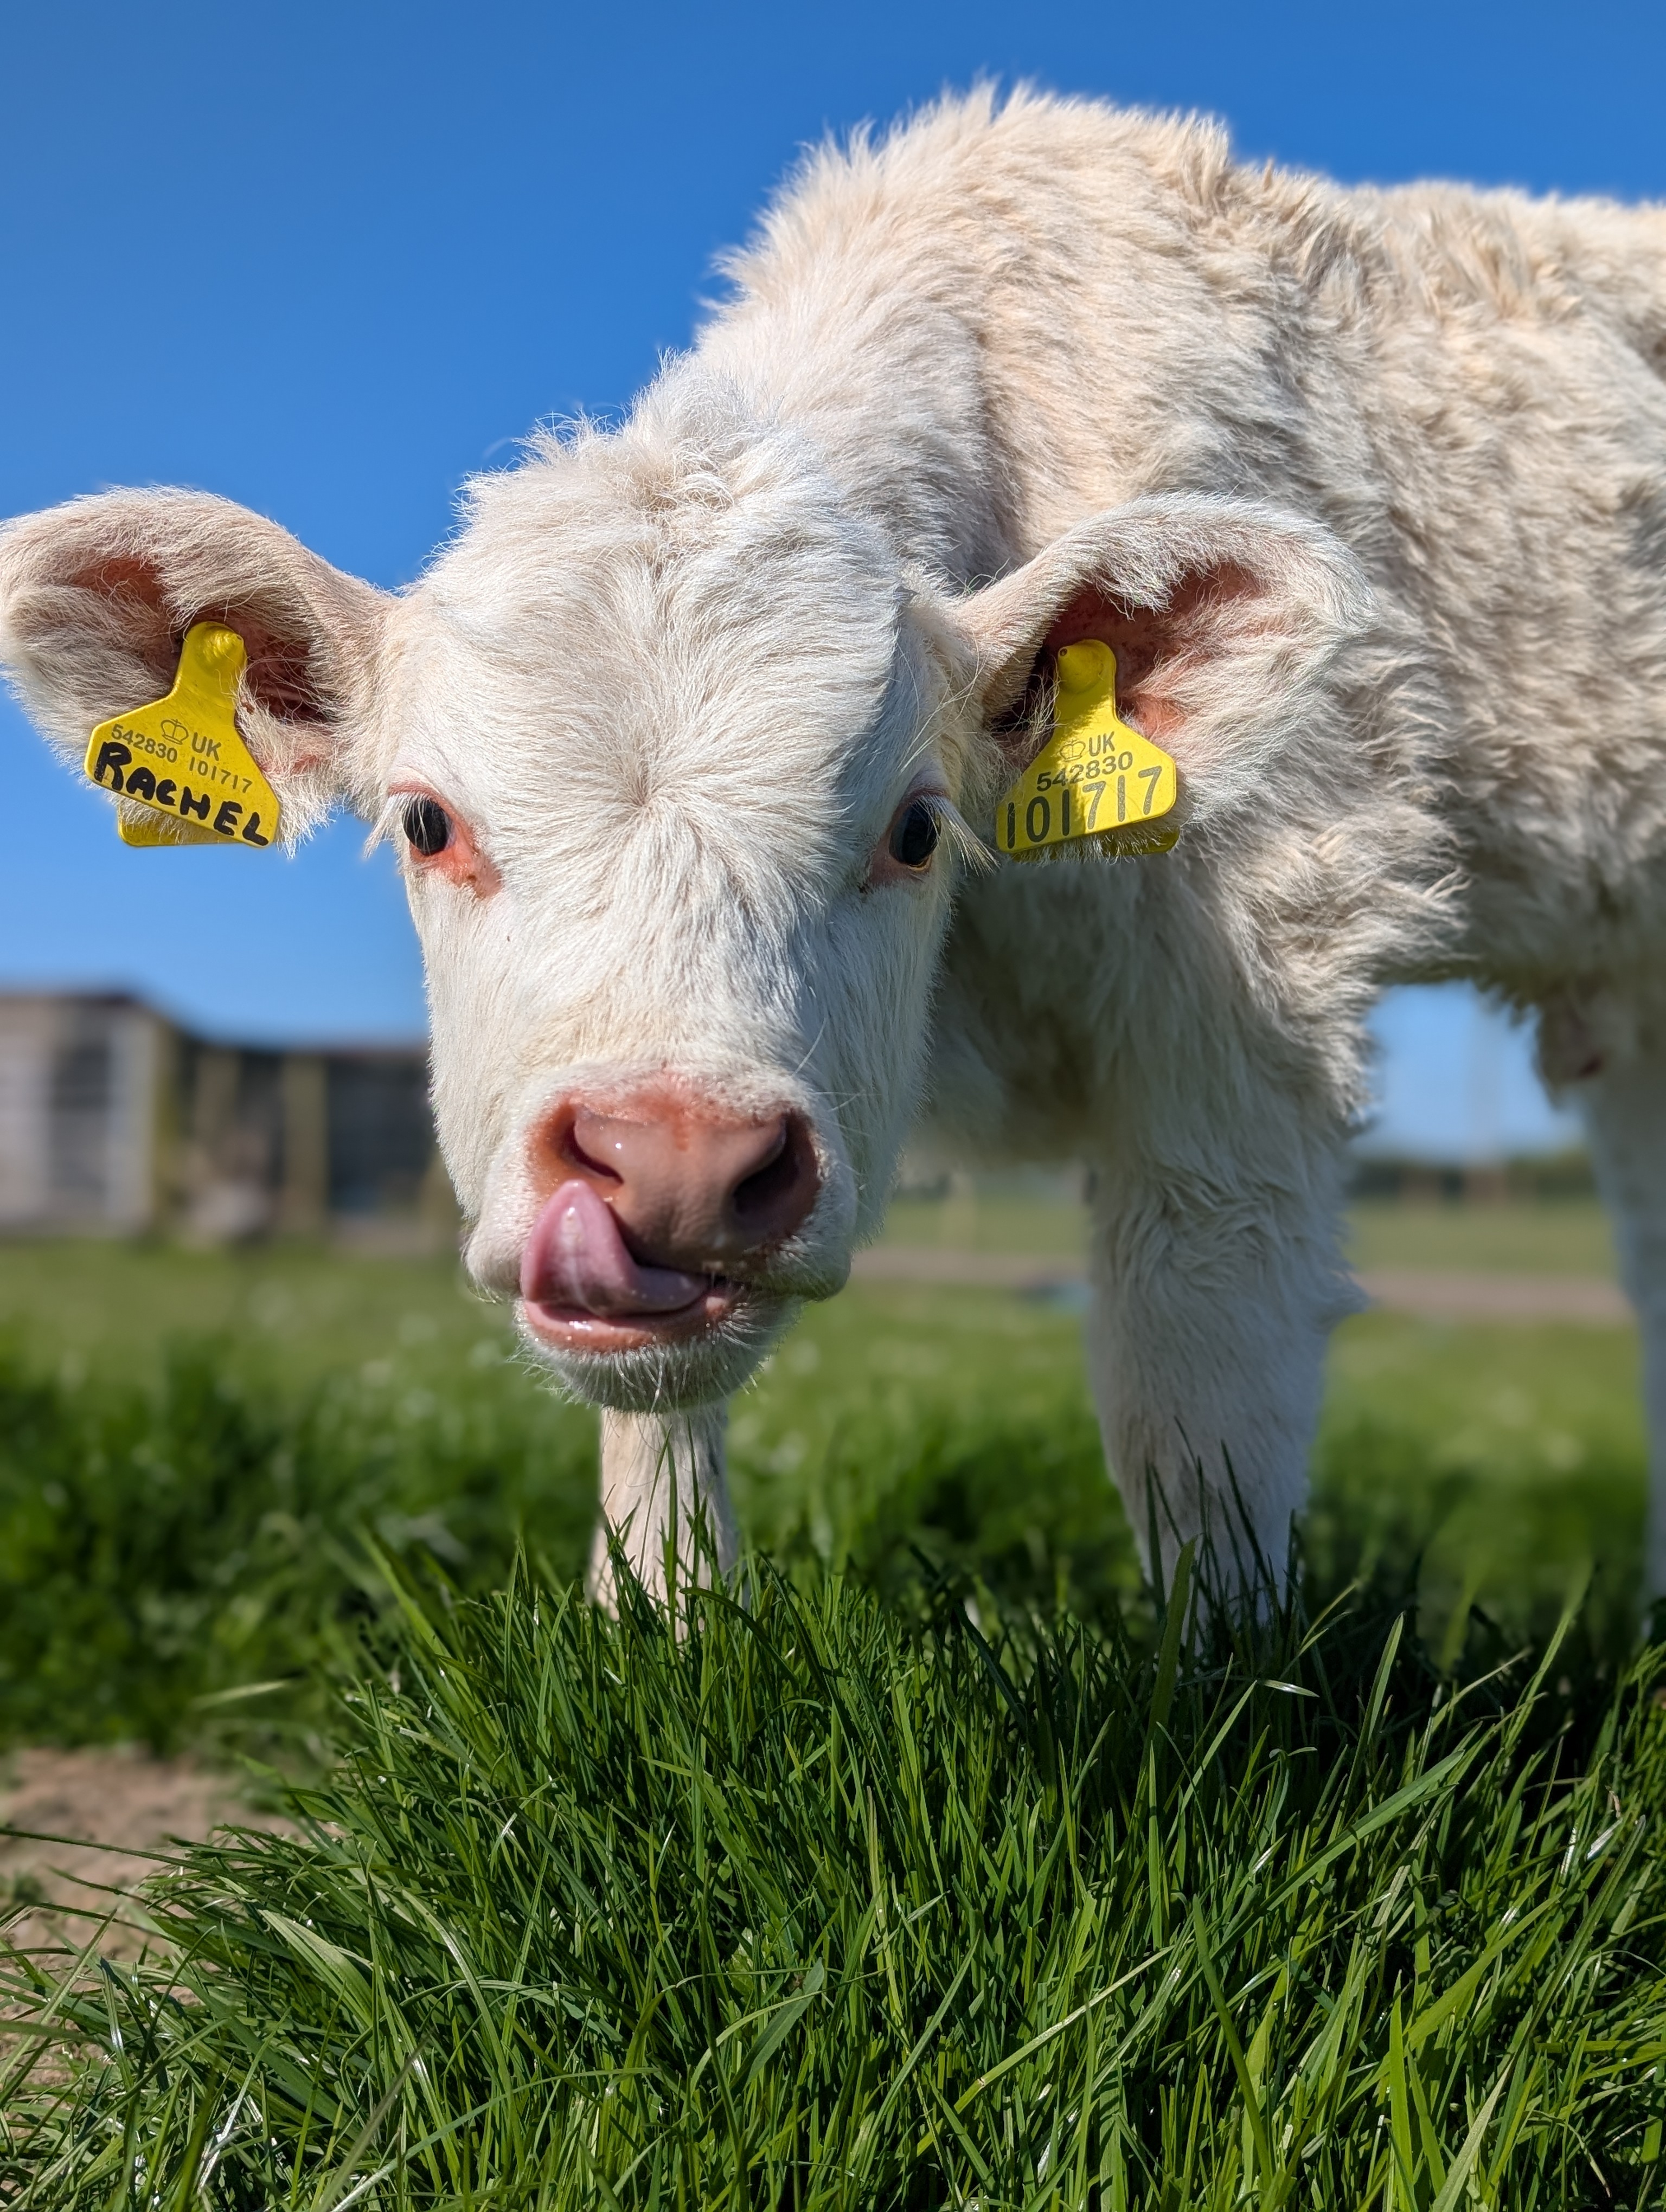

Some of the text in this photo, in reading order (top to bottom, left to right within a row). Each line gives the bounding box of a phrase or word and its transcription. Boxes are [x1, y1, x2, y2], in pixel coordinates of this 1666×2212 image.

[111, 724, 253, 793] 542830 101717
[191, 732, 222, 761] UK
[1088, 731, 1115, 756] UK
[94, 741, 269, 846] RACHEL
[1036, 751, 1133, 792] 542830
[1007, 766, 1162, 849] 101717
